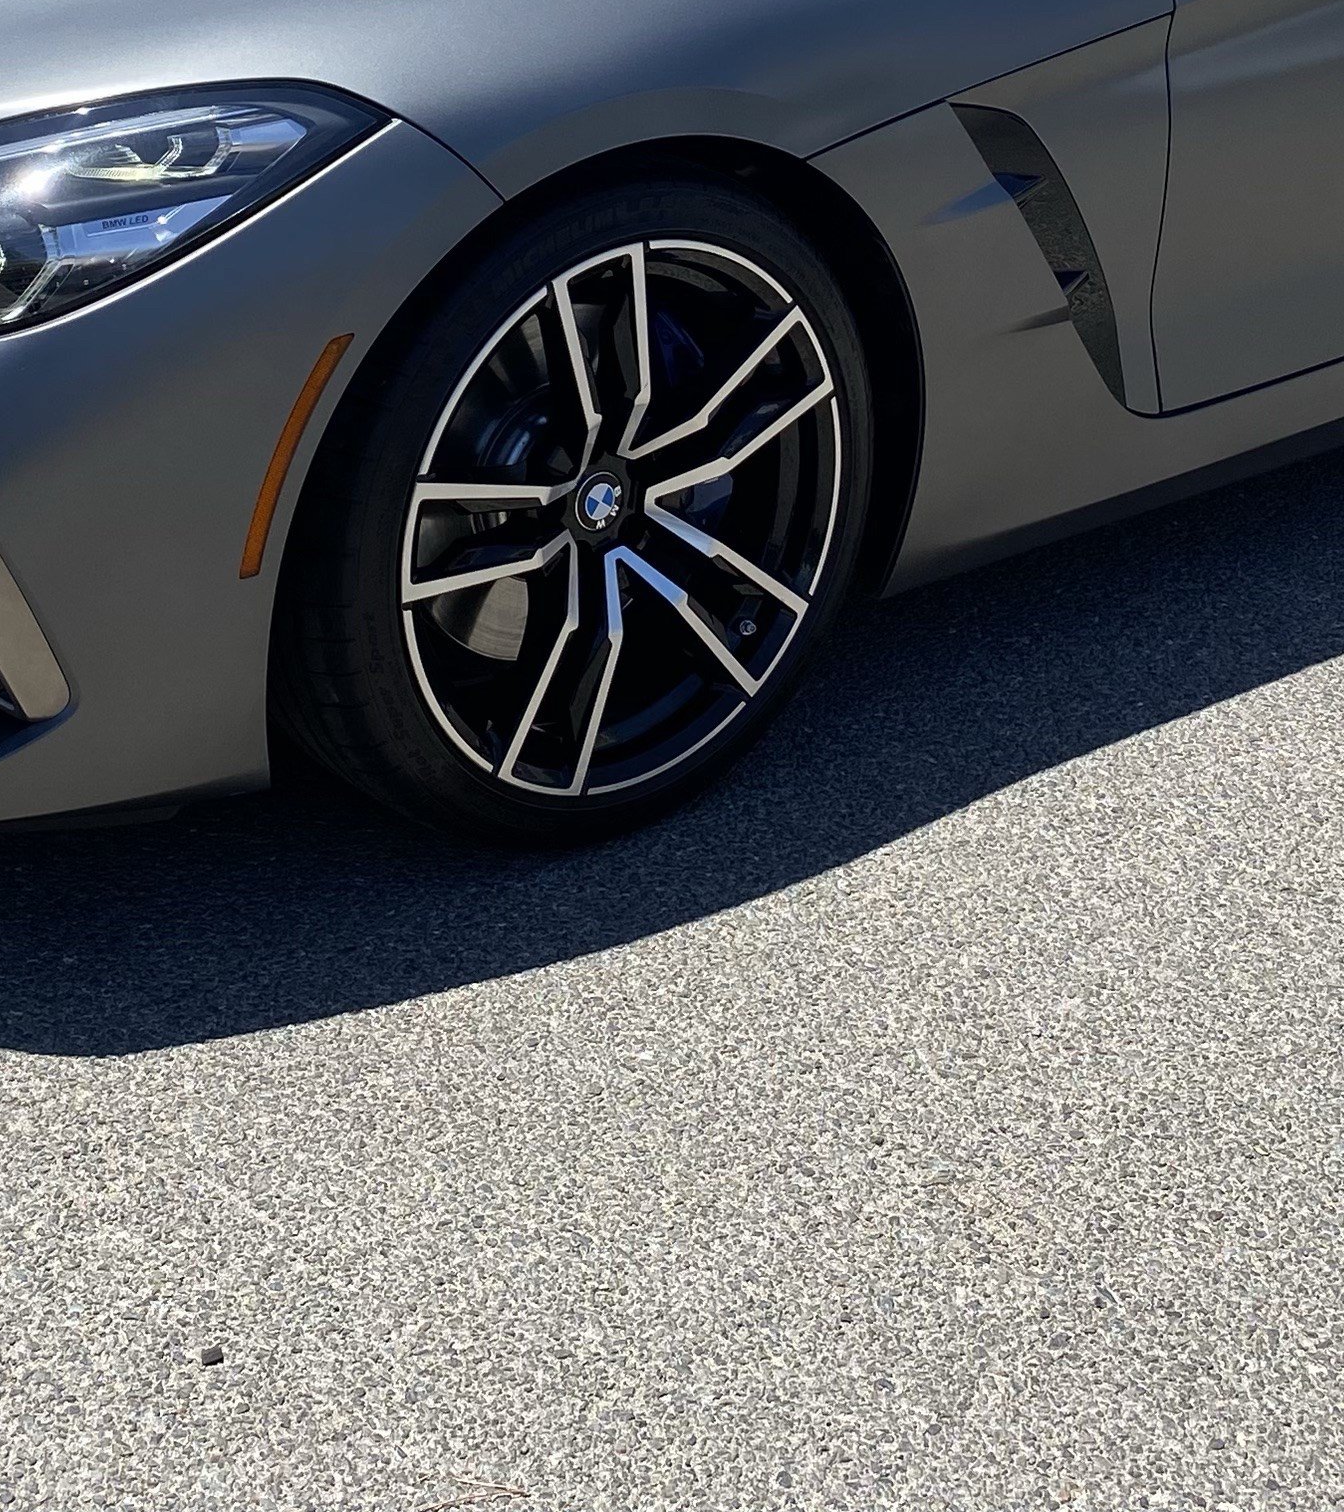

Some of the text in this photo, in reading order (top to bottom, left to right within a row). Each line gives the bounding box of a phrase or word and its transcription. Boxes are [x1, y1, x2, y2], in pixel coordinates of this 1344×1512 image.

[102, 214, 149, 229] BMW LED
[596, 485, 622, 530] BMW
